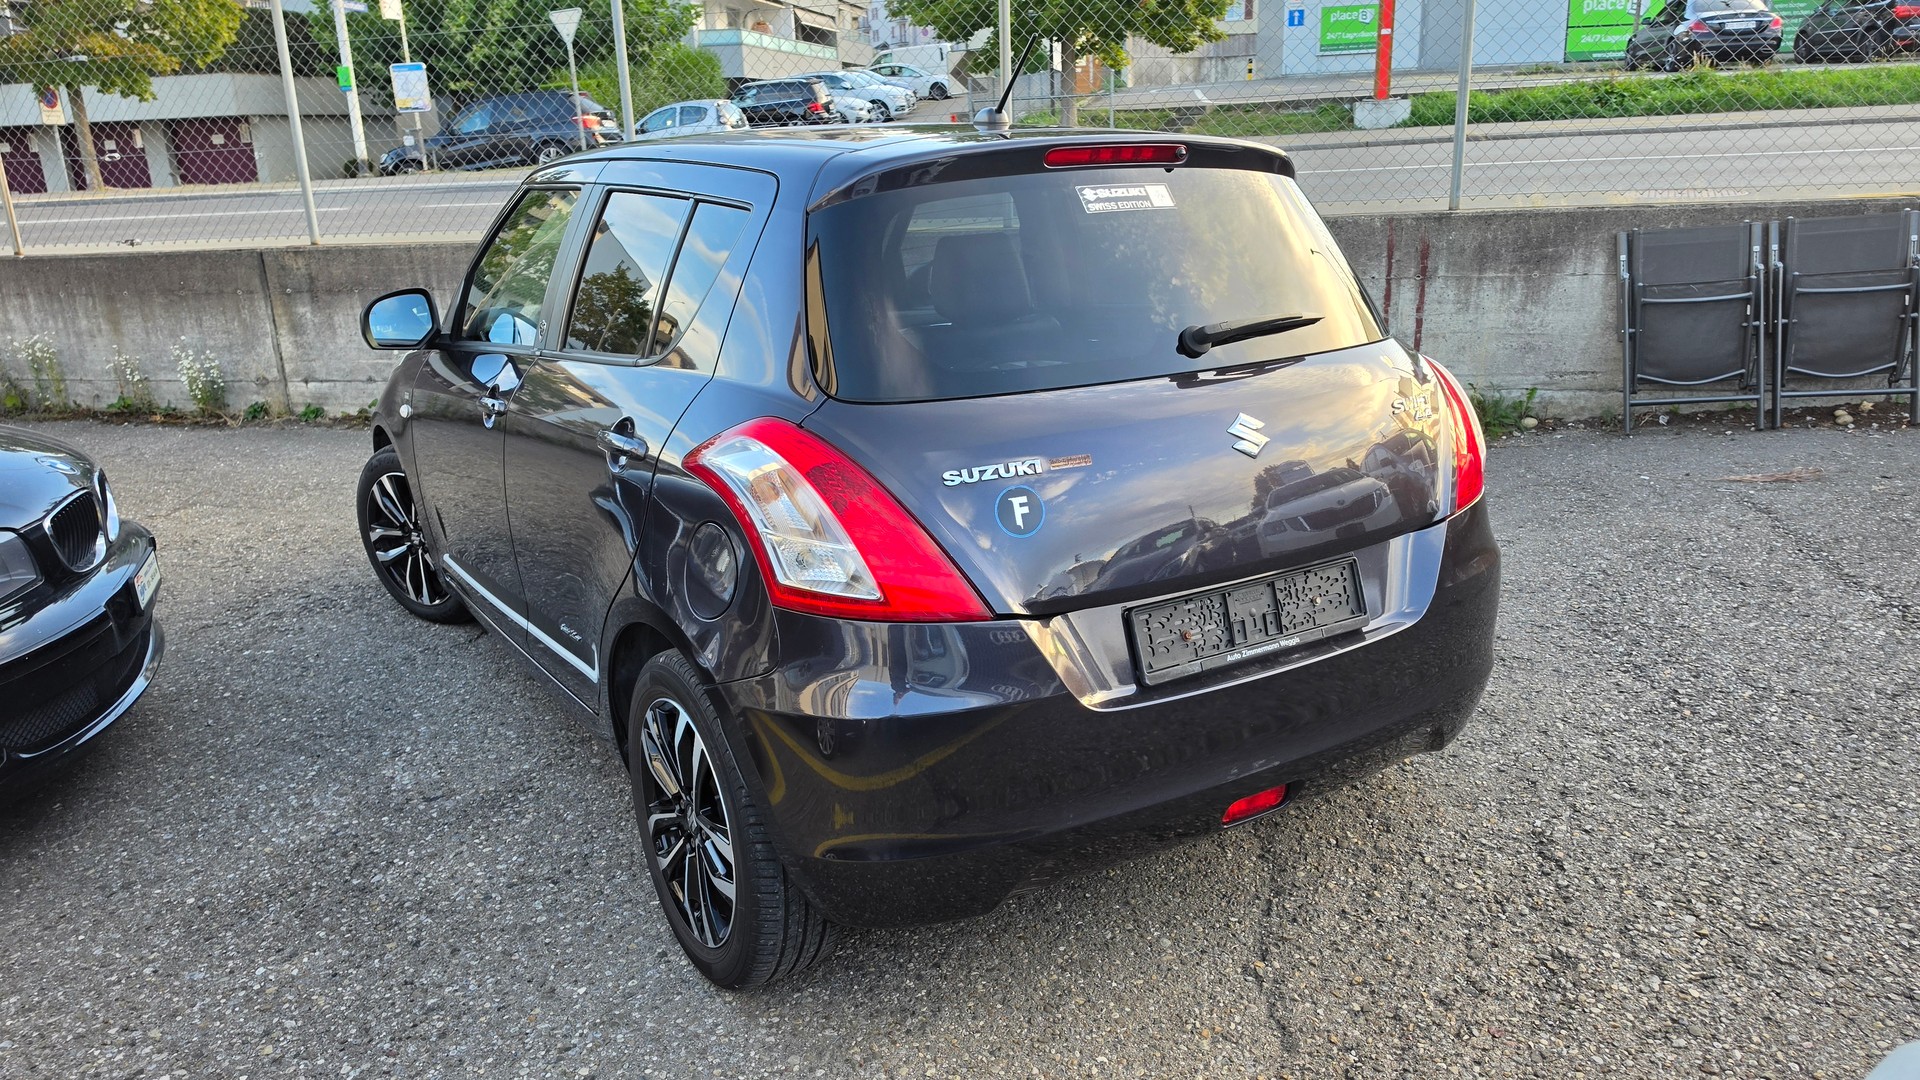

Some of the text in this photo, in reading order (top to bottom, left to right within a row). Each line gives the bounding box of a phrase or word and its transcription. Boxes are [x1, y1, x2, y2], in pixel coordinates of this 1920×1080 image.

[1330, 10, 1358, 22] place
[1096, 187, 1147, 198] SUZUKI
[1087, 200, 1152, 211] SWISS EDITION
[942, 459, 1043, 486] SUZUKI
[1008, 496, 1030, 530] F
[1227, 636, 1300, 662] Auto Zimmermann Weggis
